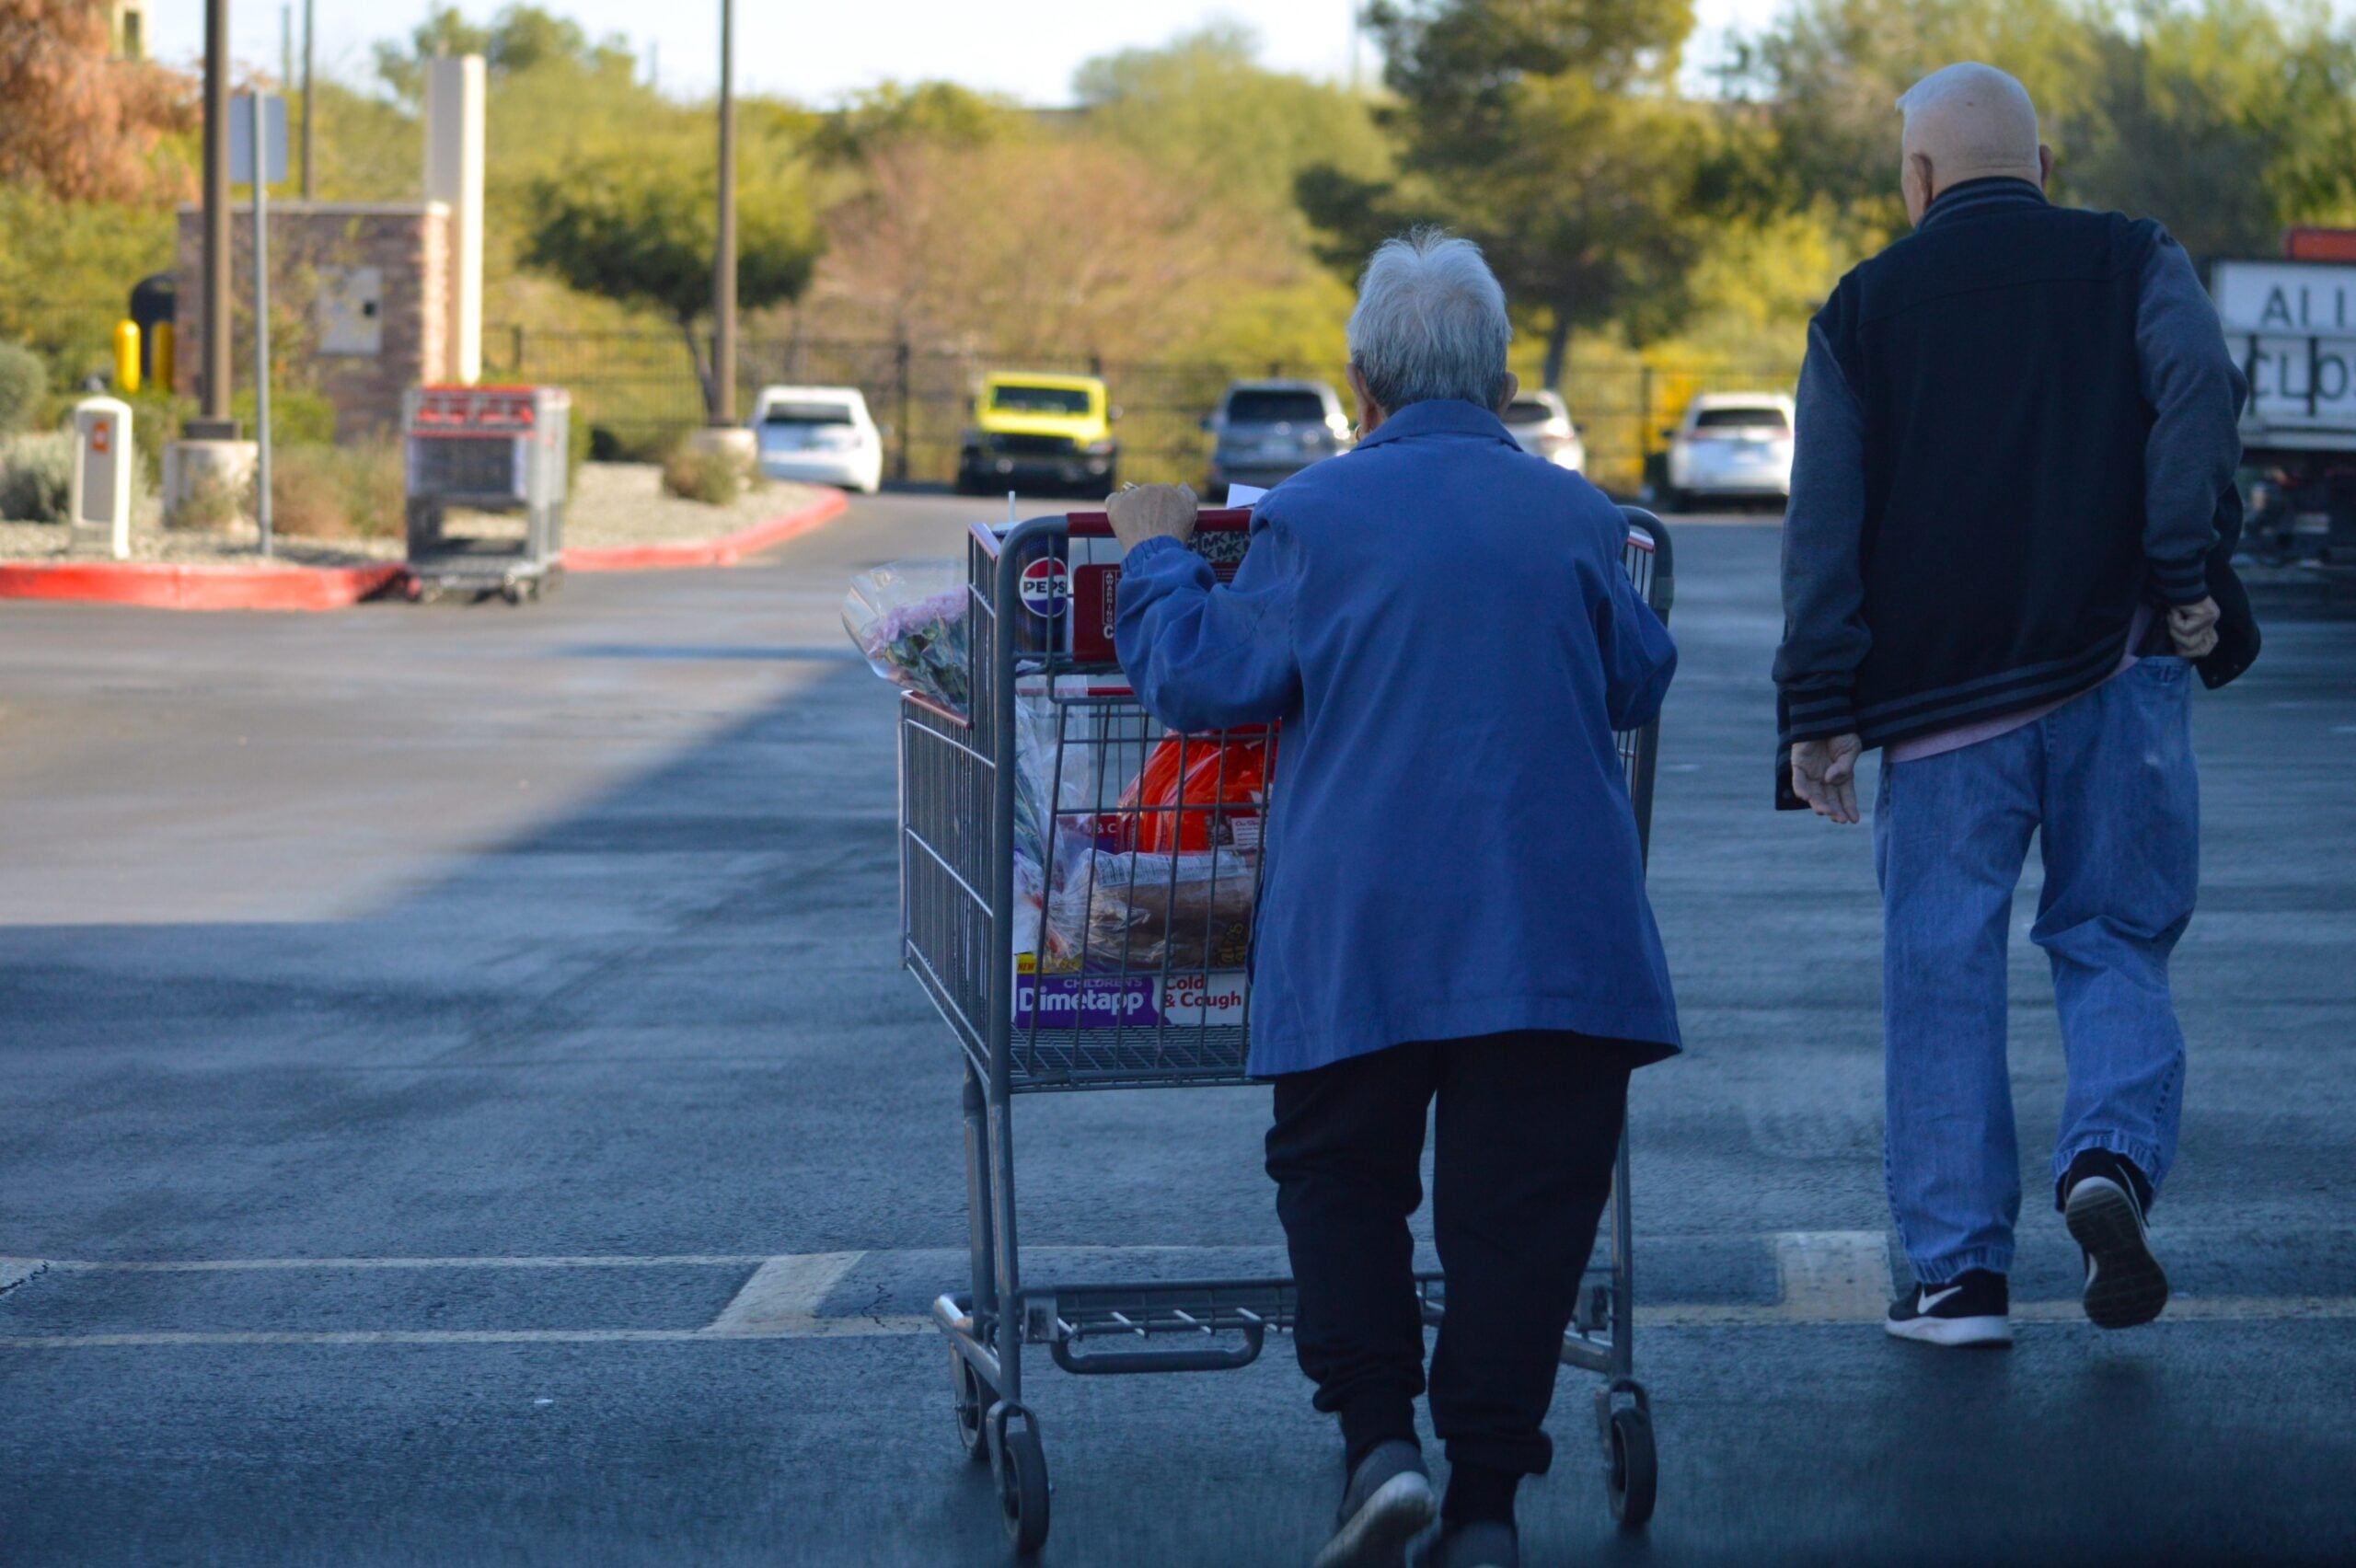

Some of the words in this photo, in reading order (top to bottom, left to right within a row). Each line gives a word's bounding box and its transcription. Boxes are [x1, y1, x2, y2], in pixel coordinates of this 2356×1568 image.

[2245, 352, 2356, 402] CLO
[1064, 977, 1143, 989] CHILDREN'S
[1165, 974, 1205, 990] Cold
[1019, 986, 1144, 1015] Dimetapp
[1163, 994, 1175, 1008] &
[1180, 991, 1242, 1009] Cough
